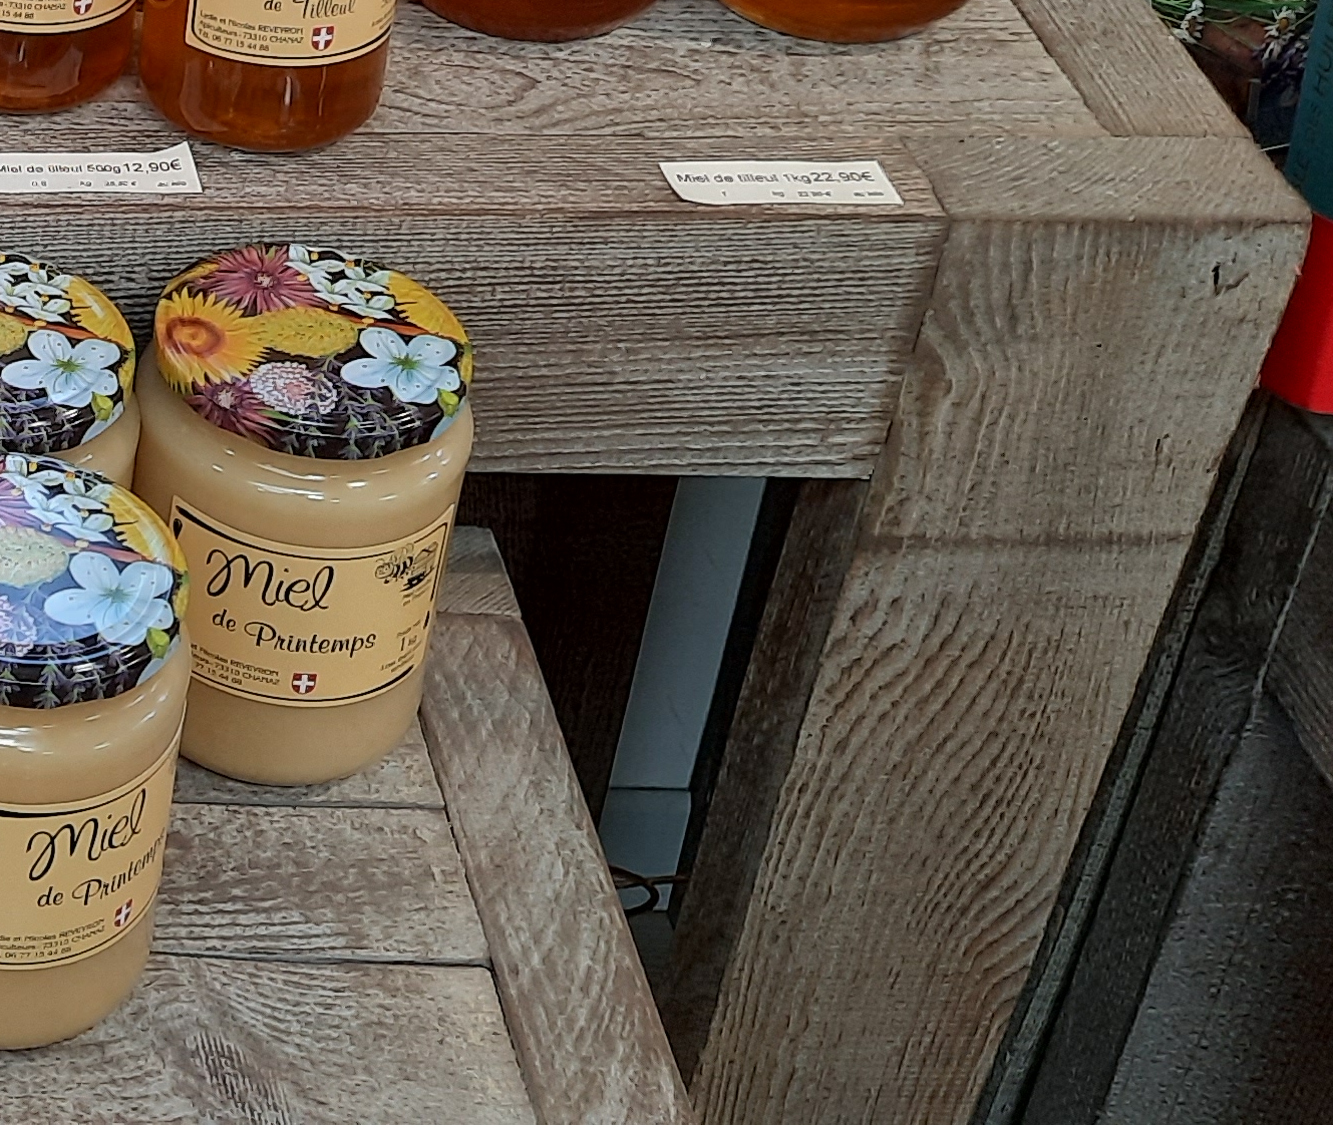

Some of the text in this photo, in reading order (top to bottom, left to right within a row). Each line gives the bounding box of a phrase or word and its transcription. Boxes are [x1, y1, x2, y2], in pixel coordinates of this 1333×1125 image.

[26, 164, 44, 174] de
[48, 163, 83, 174] tilleul
[86, 163, 121, 175] 500g
[123, 158, 183, 175] 12,90€
[676, 173, 711, 183] Miel
[713, 174, 734, 183] de
[739, 173, 779, 183] tilleul
[811, 170, 876, 184] 22,90€
[205, 548, 335, 612] Miel
[211, 608, 378, 658] de Printemps
[25, 787, 147, 881] Miel
[36, 885, 64, 908] de
